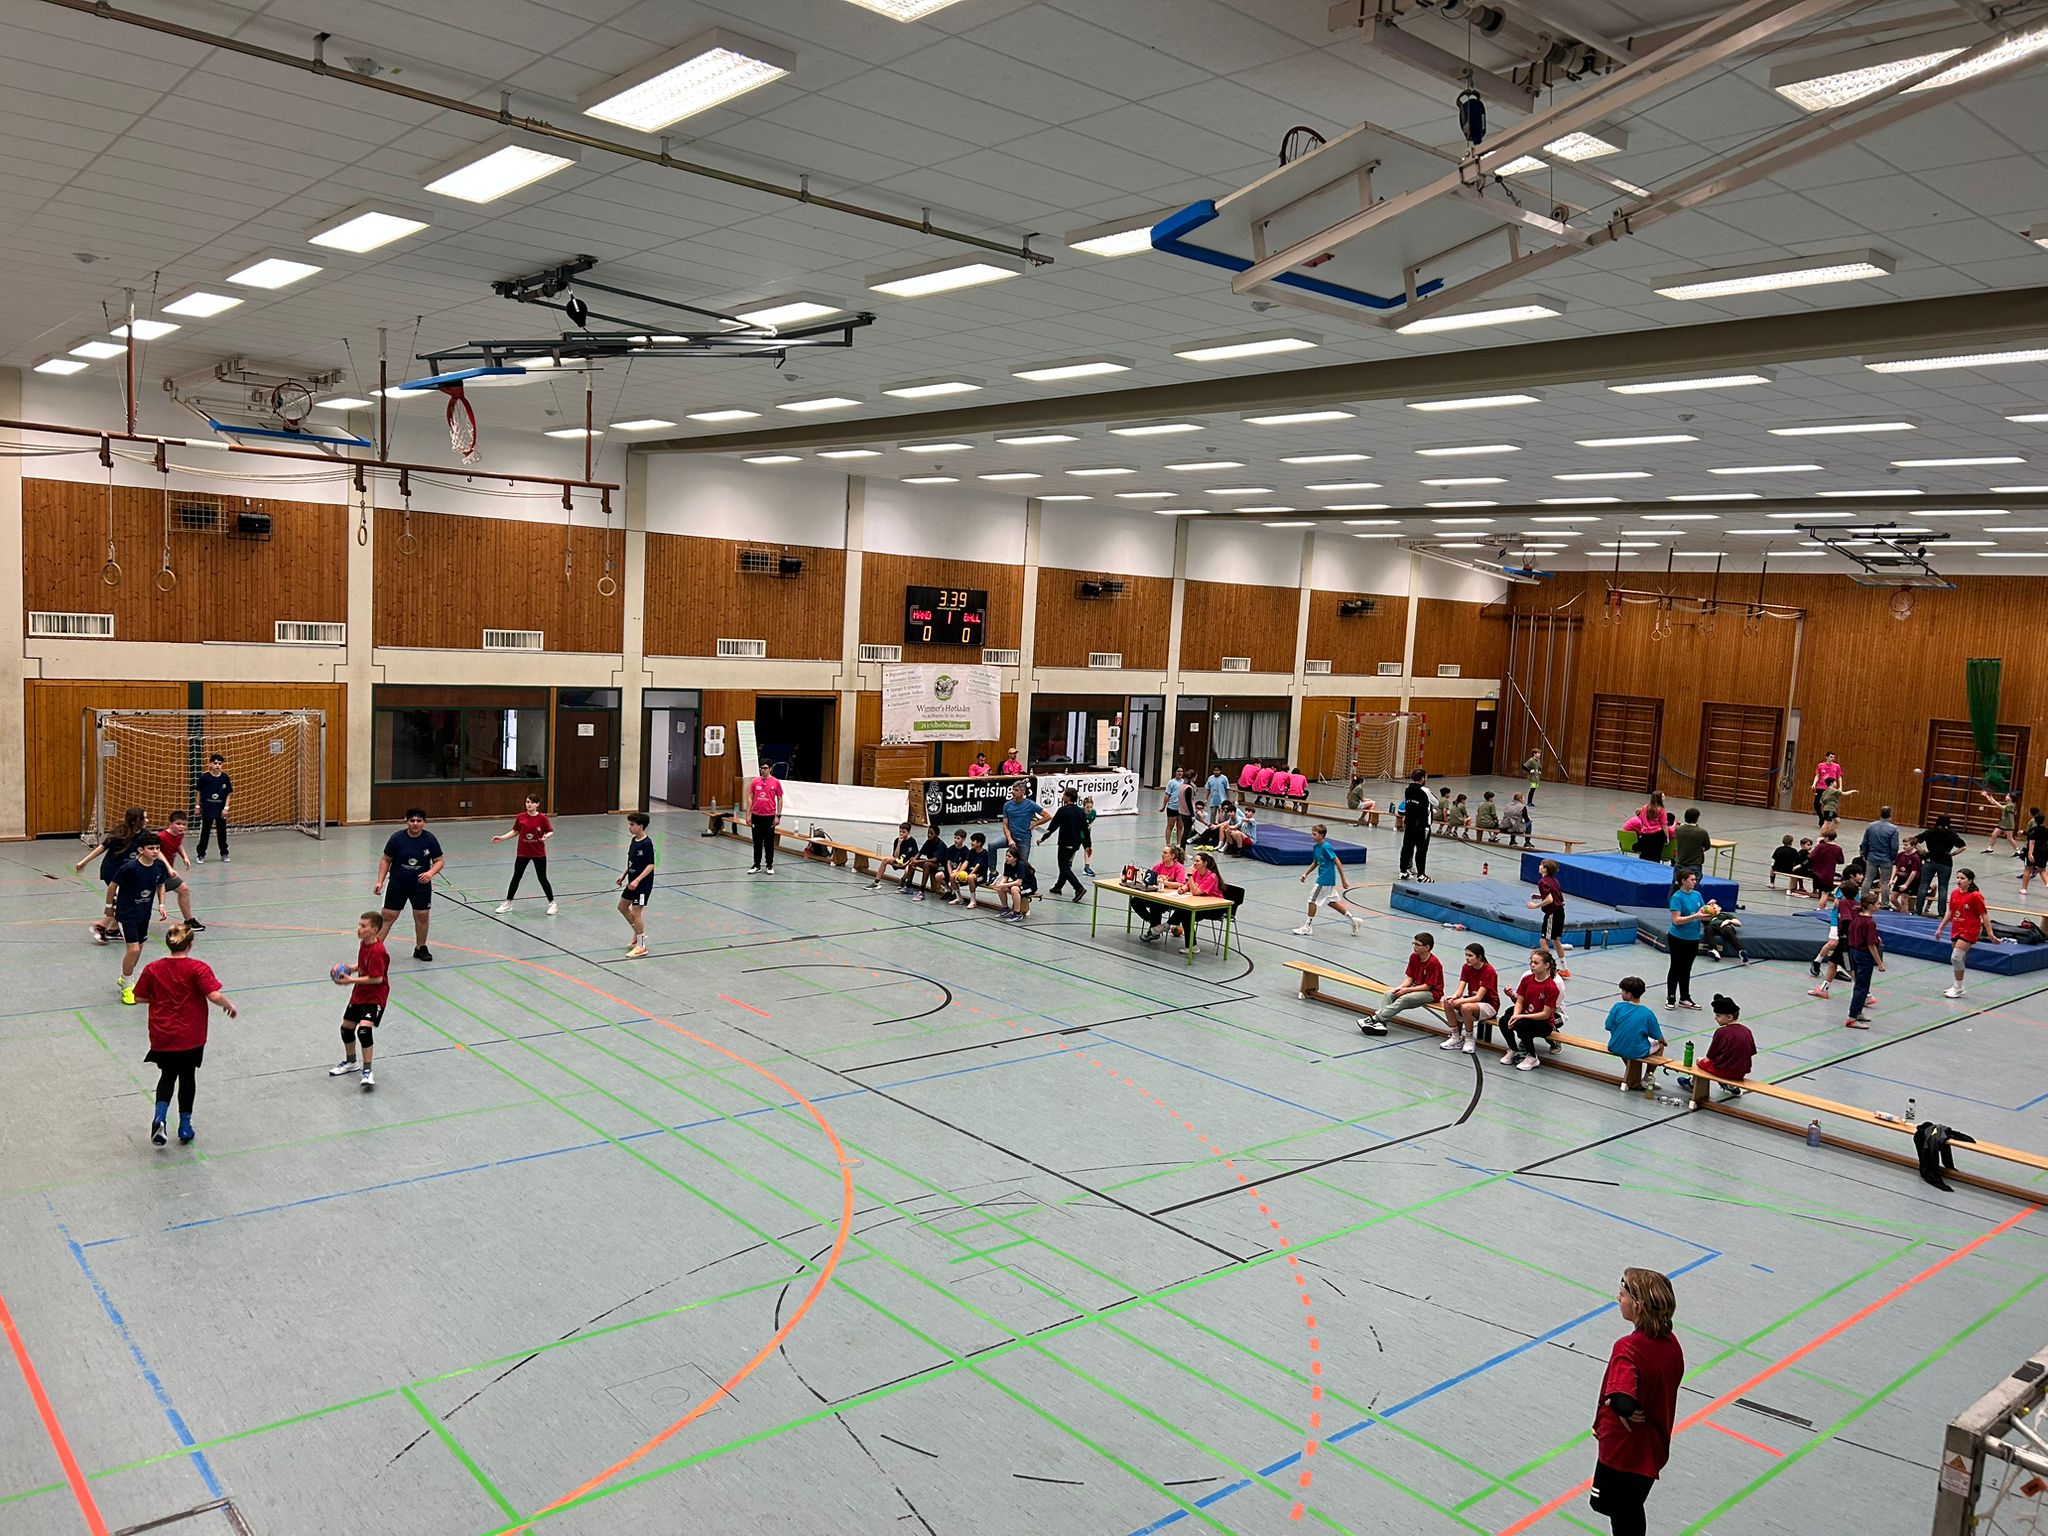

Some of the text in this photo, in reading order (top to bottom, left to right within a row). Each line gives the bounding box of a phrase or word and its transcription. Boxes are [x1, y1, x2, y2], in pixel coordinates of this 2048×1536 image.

[912, 609, 932, 620] HAND
[947, 611, 952, 624] 1
[963, 612, 981, 623] BALL
[923, 626, 932, 641] 0
[962, 628, 970, 642] 0
[946, 782, 1014, 800] SC Freising
[1058, 778, 1119, 795] SC Freising
[945, 801, 982, 814] Handball
[1145, 873, 1152, 882] 2
